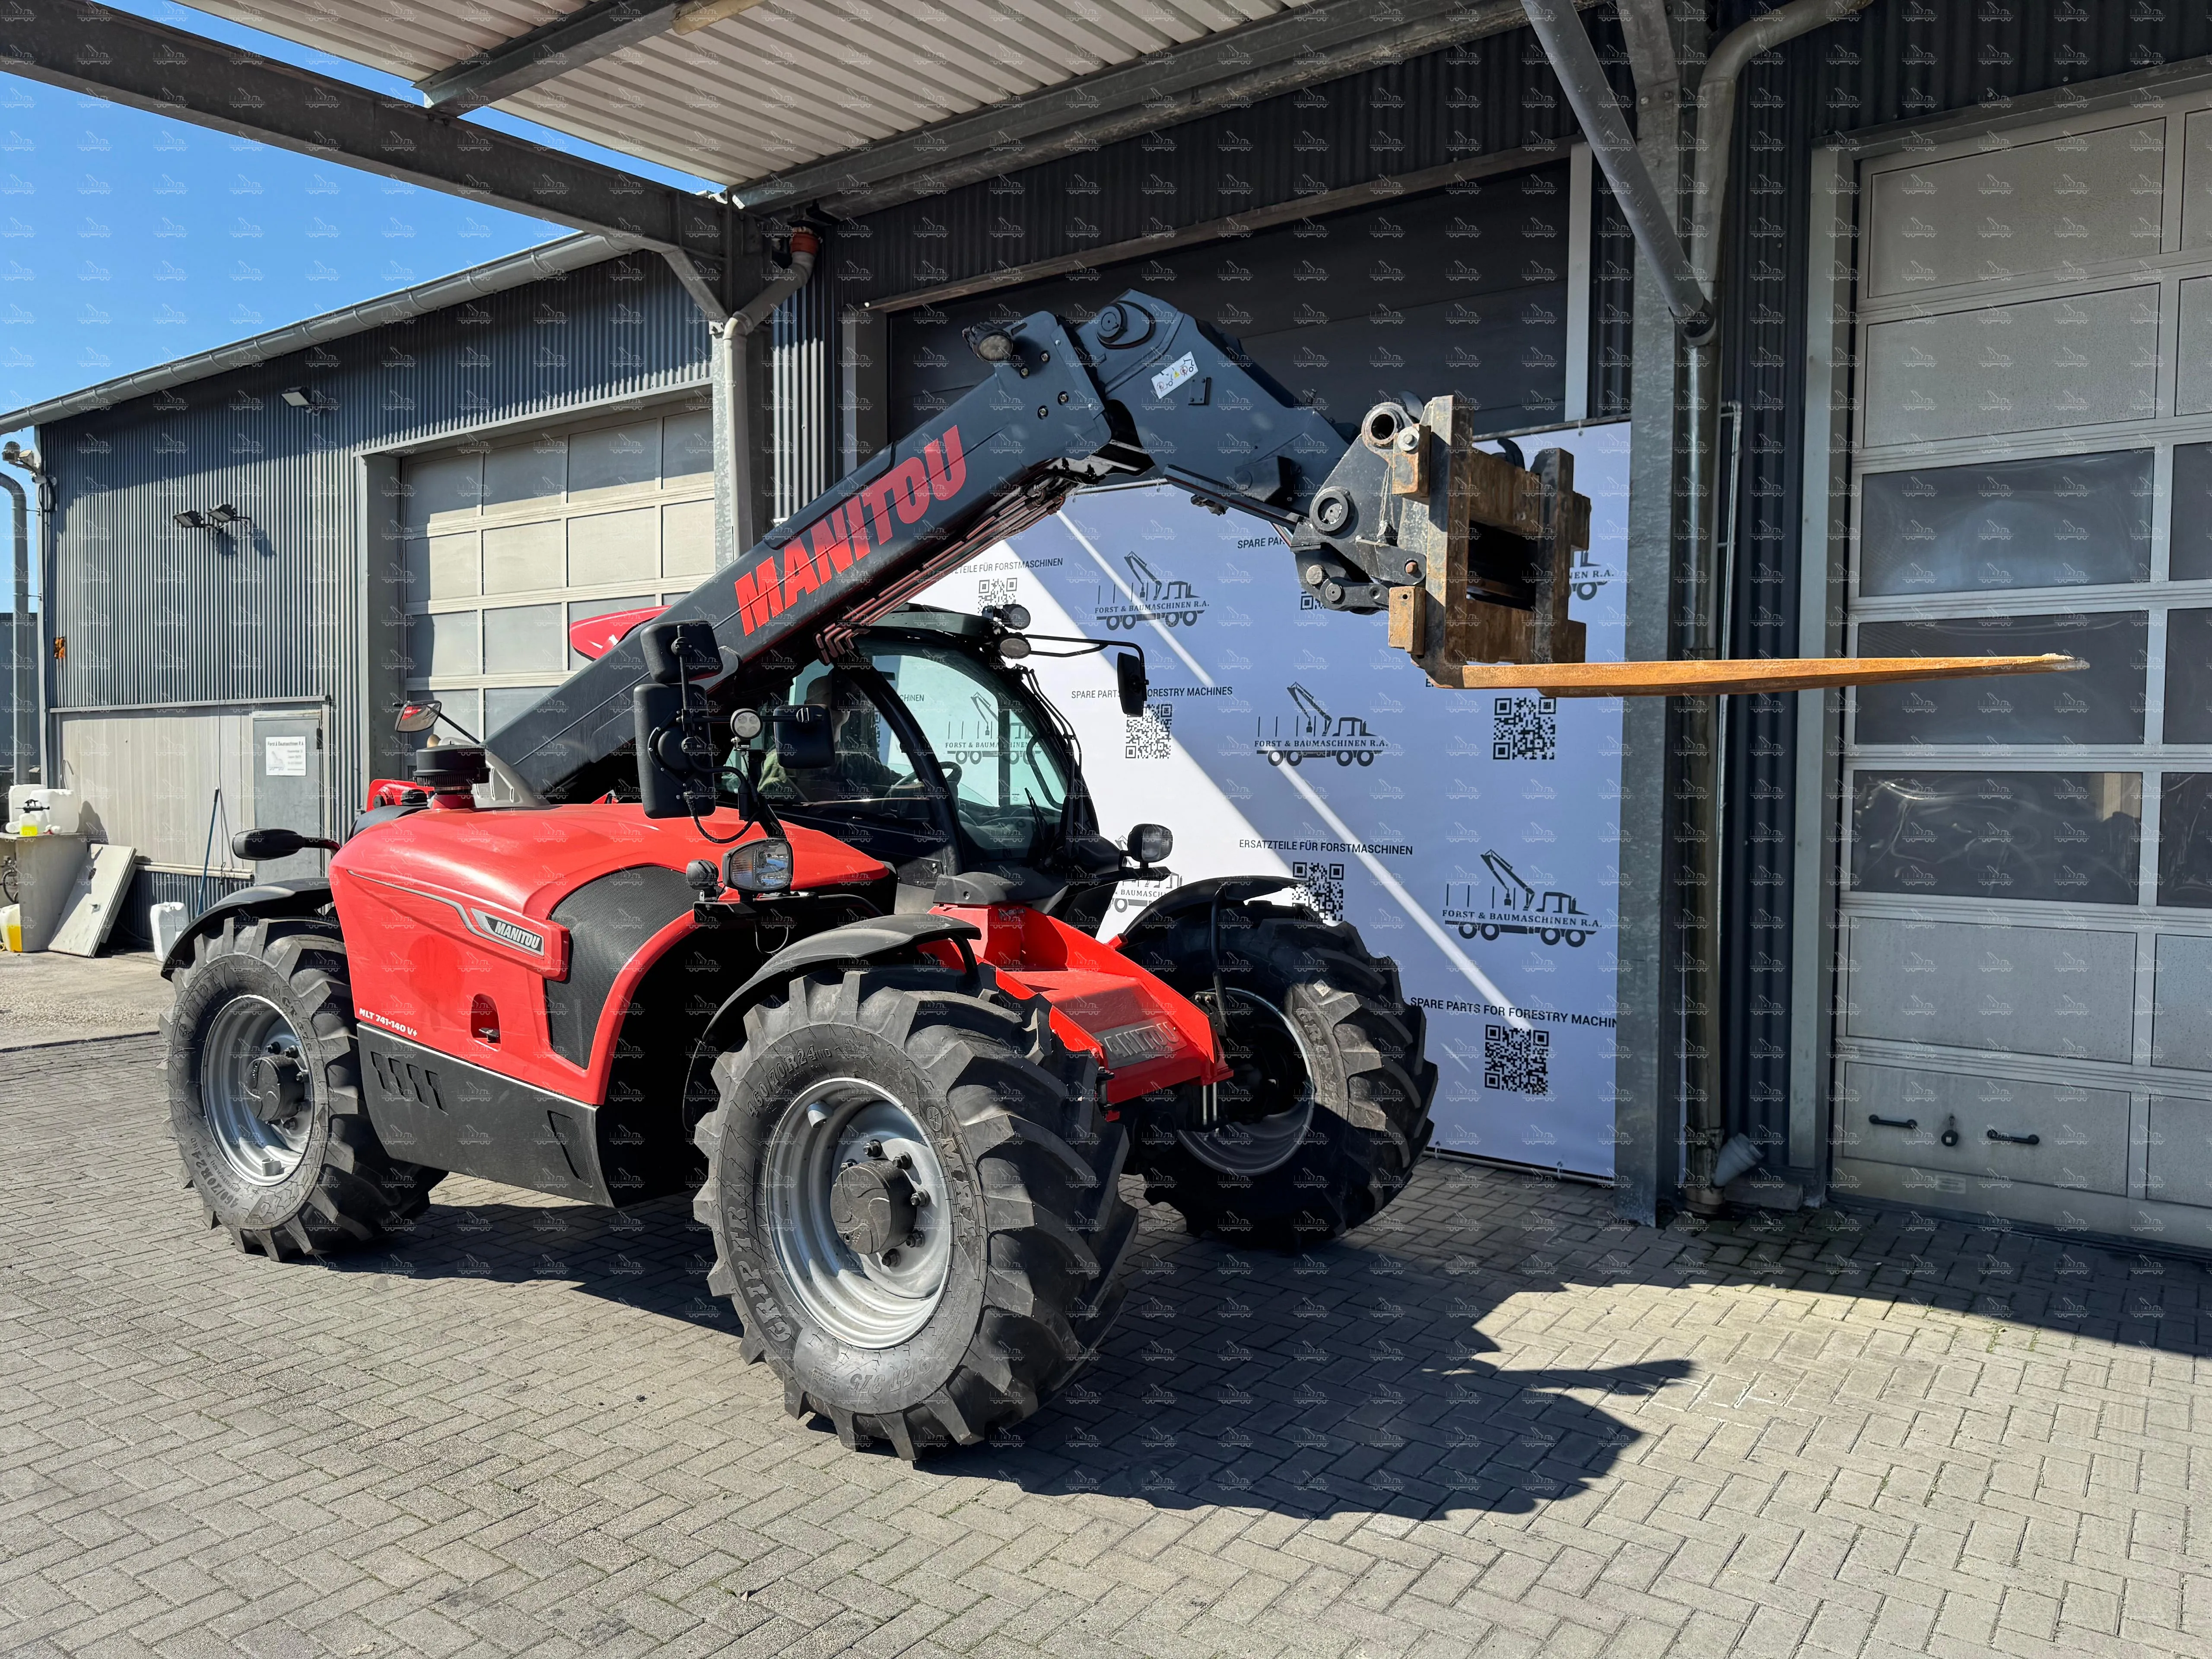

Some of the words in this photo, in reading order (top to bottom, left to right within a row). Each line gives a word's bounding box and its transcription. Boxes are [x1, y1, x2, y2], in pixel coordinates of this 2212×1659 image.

[734, 425, 966, 636] MANITOU
[1237, 537, 1266, 549] SPARE
[979, 563, 993, 572] FÜR
[995, 558, 1063, 571] FORSTMASCHINEN
[1129, 602, 1191, 611] BAUMASCHINEN
[1071, 690, 1096, 699] SPARE
[1147, 687, 1185, 697] ORESTRY
[1187, 686, 1233, 696] MACHINES
[1239, 839, 1297, 850] ERSATZTEILE
[1299, 840, 1318, 851] FÜR
[1320, 842, 1413, 855] FORSTMASCHINEN
[1490, 913, 1576, 925] BAUMASCHINEN
[1581, 919, 1602, 927] R.A.
[495, 921, 540, 949] MANITOU
[359, 1007, 374, 1020] MLT
[375, 1013, 406, 1033] 741-140
[407, 1024, 418, 1036] V+
[1410, 997, 1443, 1009] SPARE
[1446, 1001, 1481, 1013] PARTS
[1484, 1004, 1505, 1016] FOR
[1509, 1007, 1568, 1023] FORESTRY
[1104, 1021, 1180, 1058] ANITOU
[746, 1044, 817, 1118] 460/70R24
[191, 1149, 239, 1208] 460/70R24
[737, 1260, 792, 1342] GRIP
[849, 1373, 886, 1394] 375
